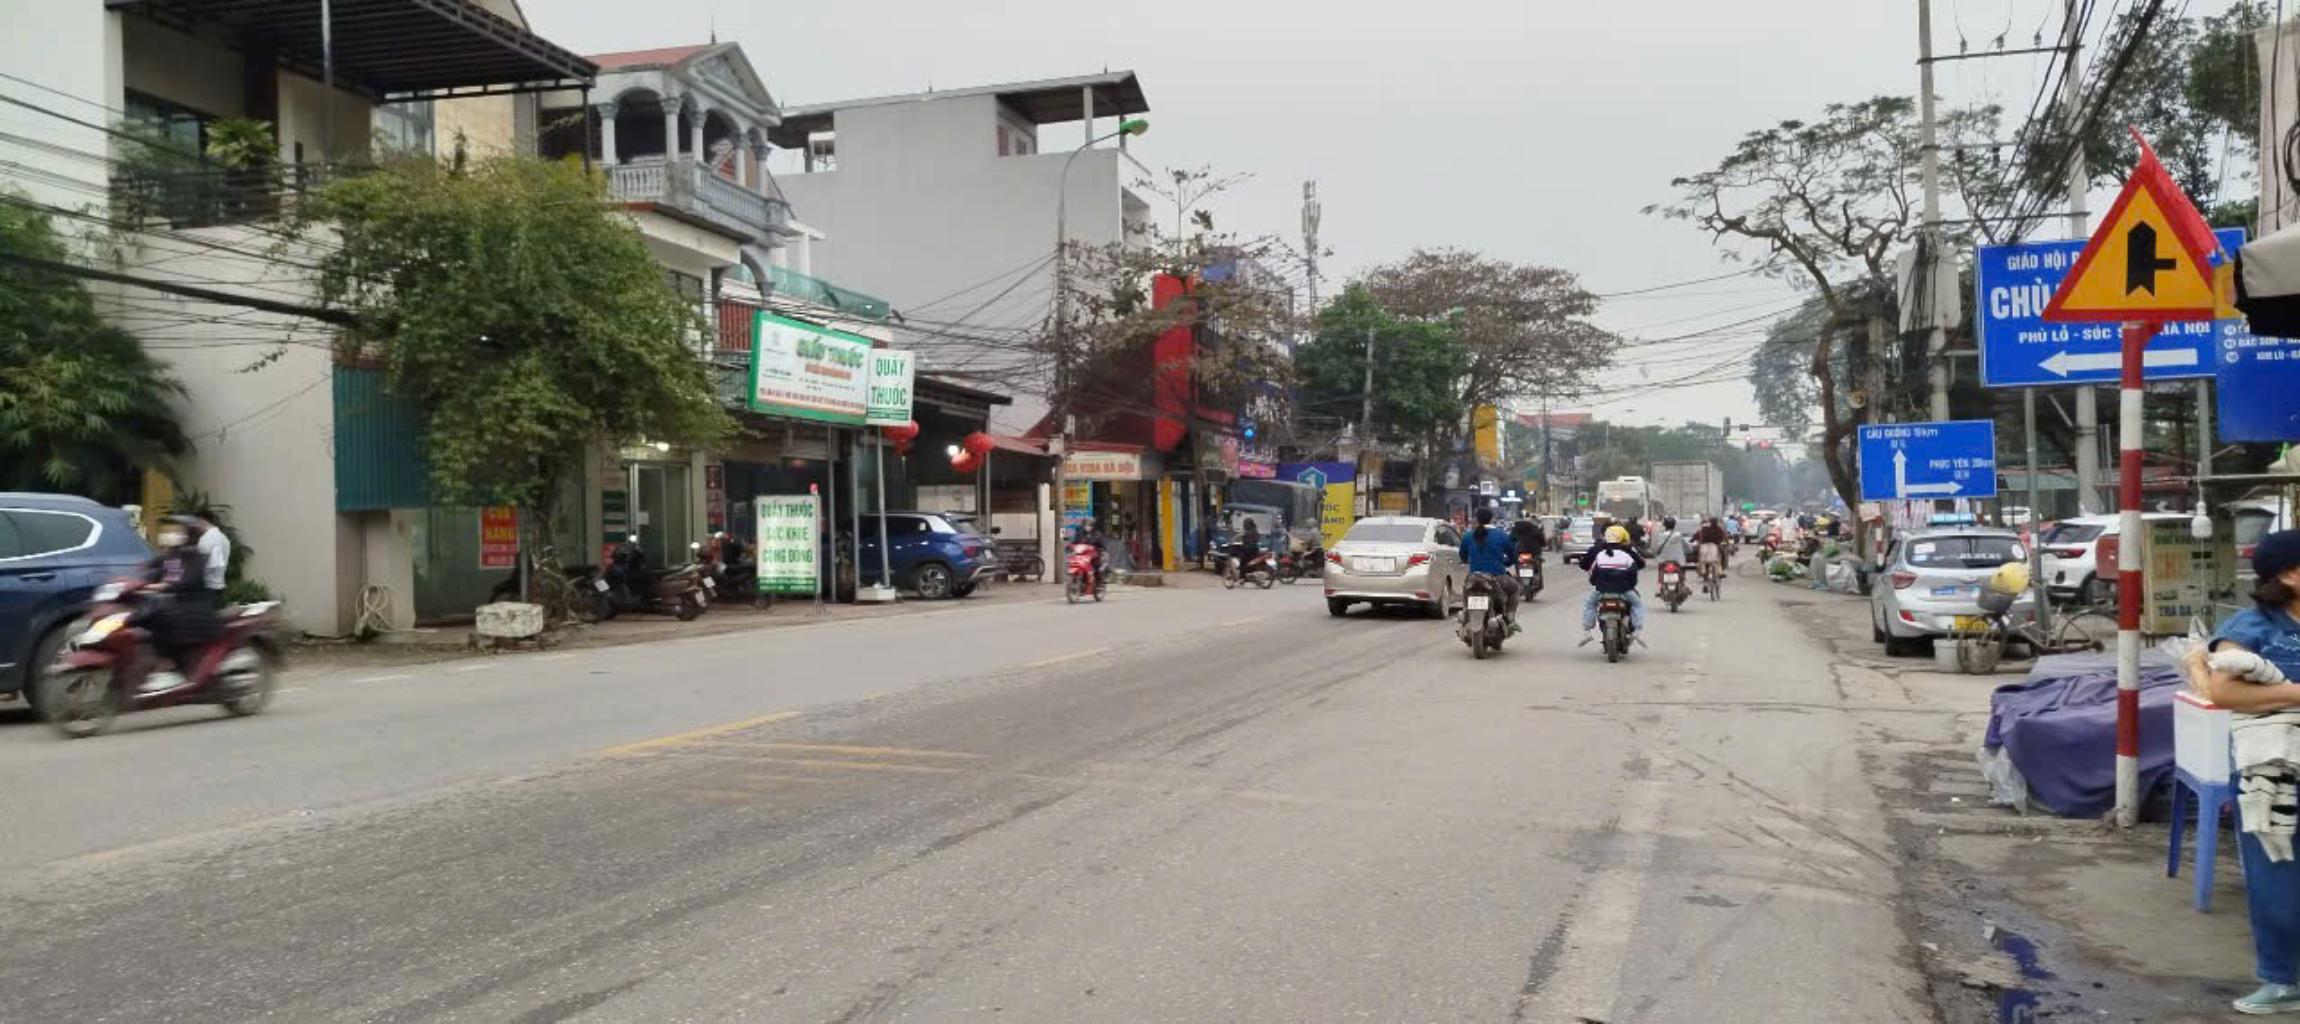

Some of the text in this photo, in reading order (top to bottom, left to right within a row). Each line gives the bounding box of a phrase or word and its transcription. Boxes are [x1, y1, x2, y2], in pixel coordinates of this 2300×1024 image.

[2007, 251, 2038, 271] GIÁO
[2044, 249, 2066, 270] HỘI
[1991, 277, 2061, 318] CHÙ
[2082, 325, 2111, 340] SÓC
[2184, 321, 2210, 336] NỘI
